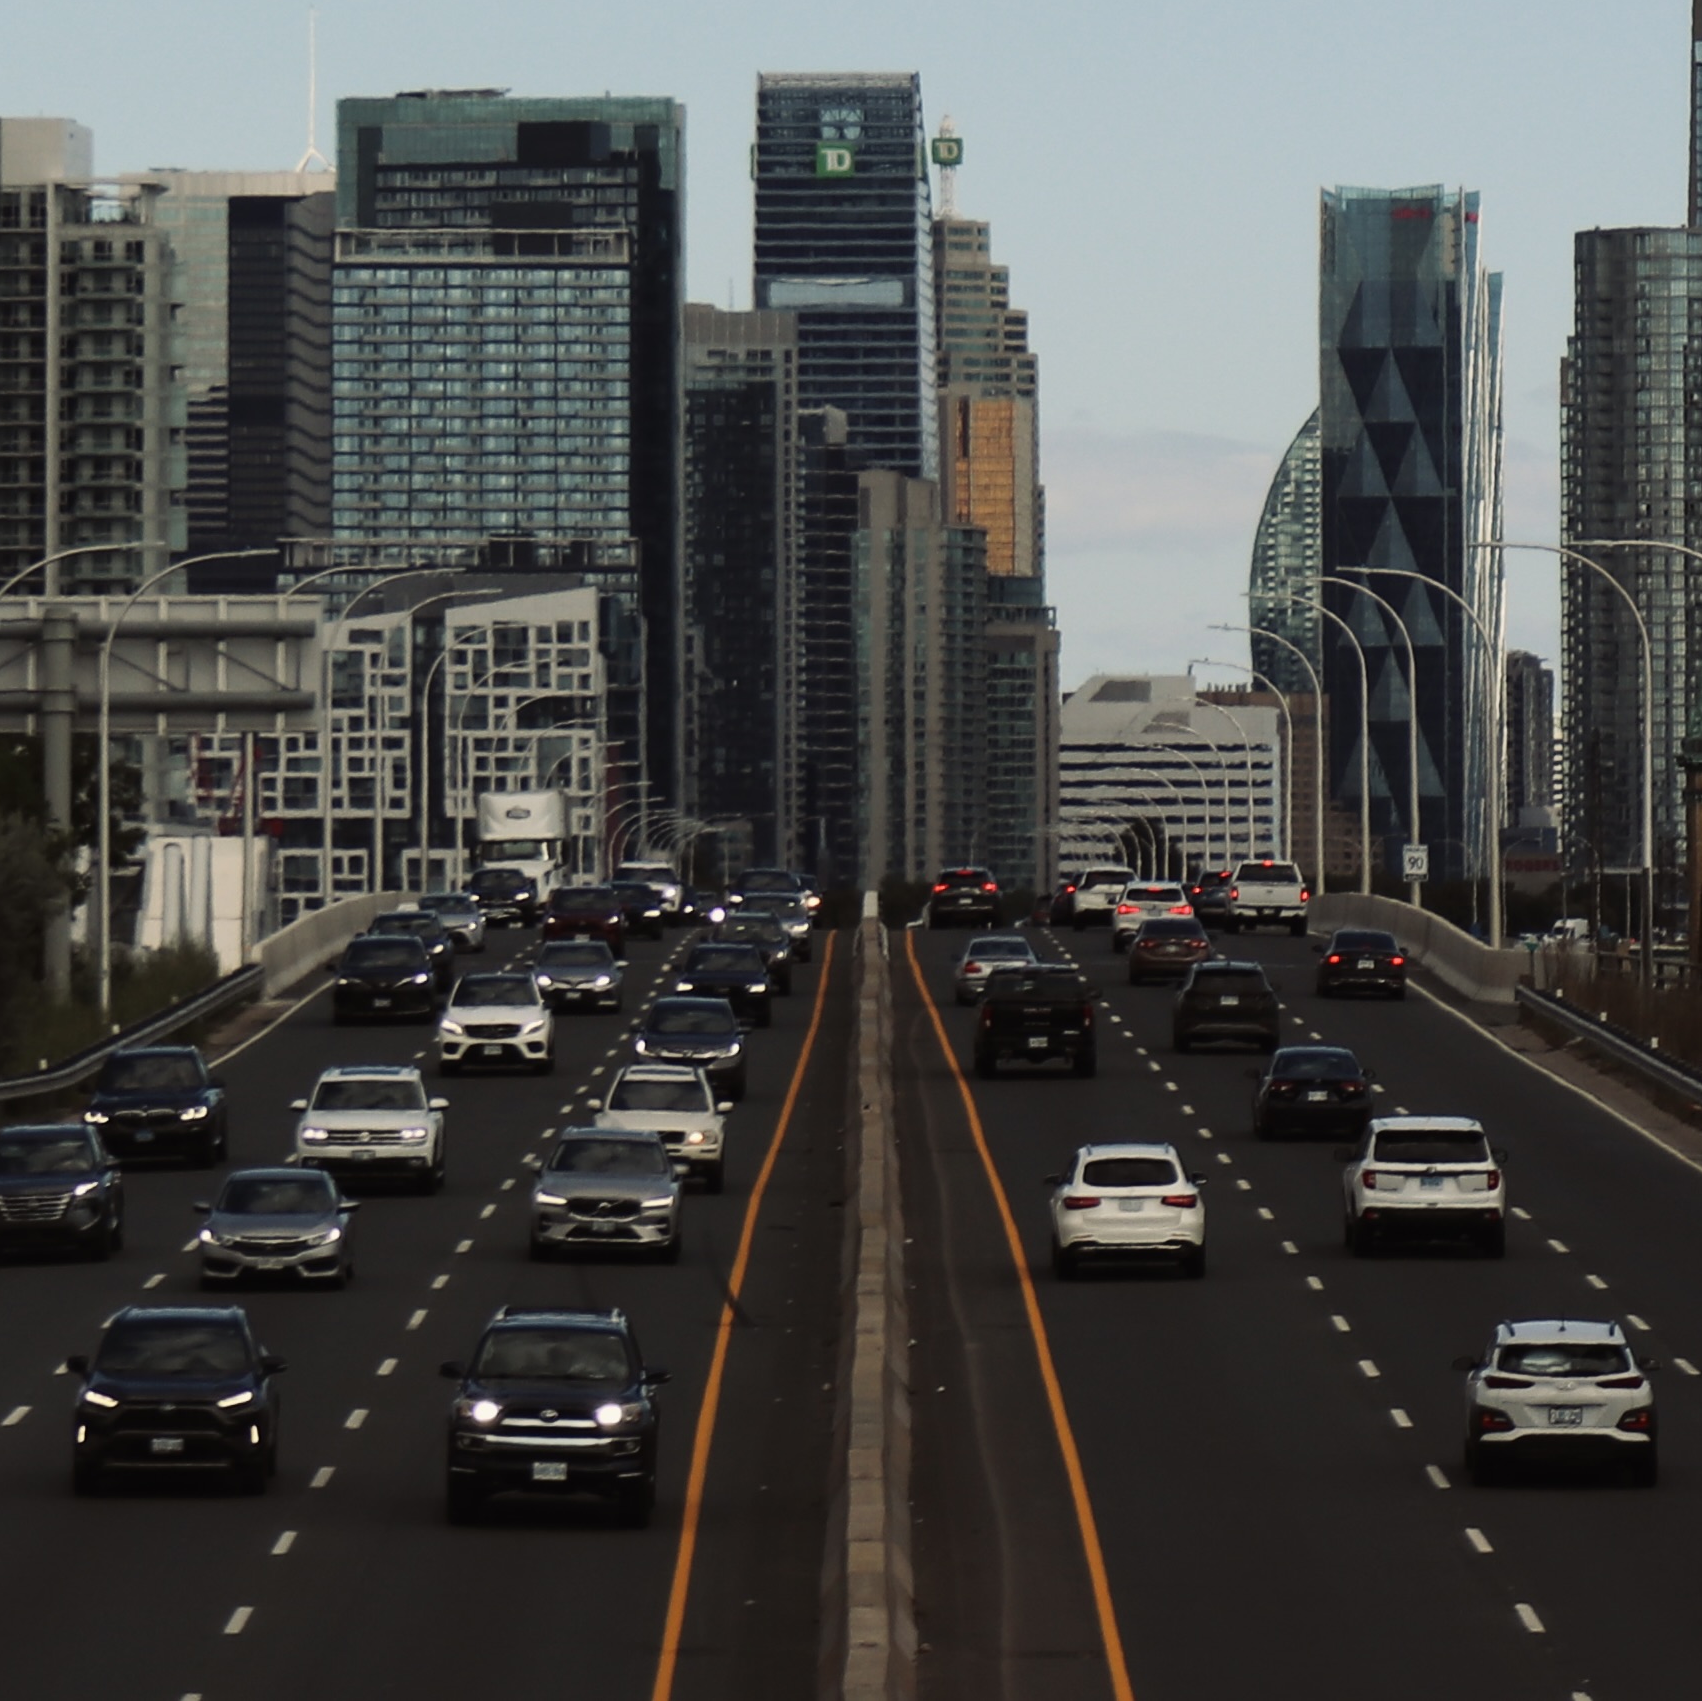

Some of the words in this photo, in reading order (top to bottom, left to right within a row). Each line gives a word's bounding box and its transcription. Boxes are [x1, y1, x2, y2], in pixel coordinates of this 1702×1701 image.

[935, 141, 959, 159] TD
[821, 149, 852, 171] TD
[1408, 855, 1424, 871] 90
